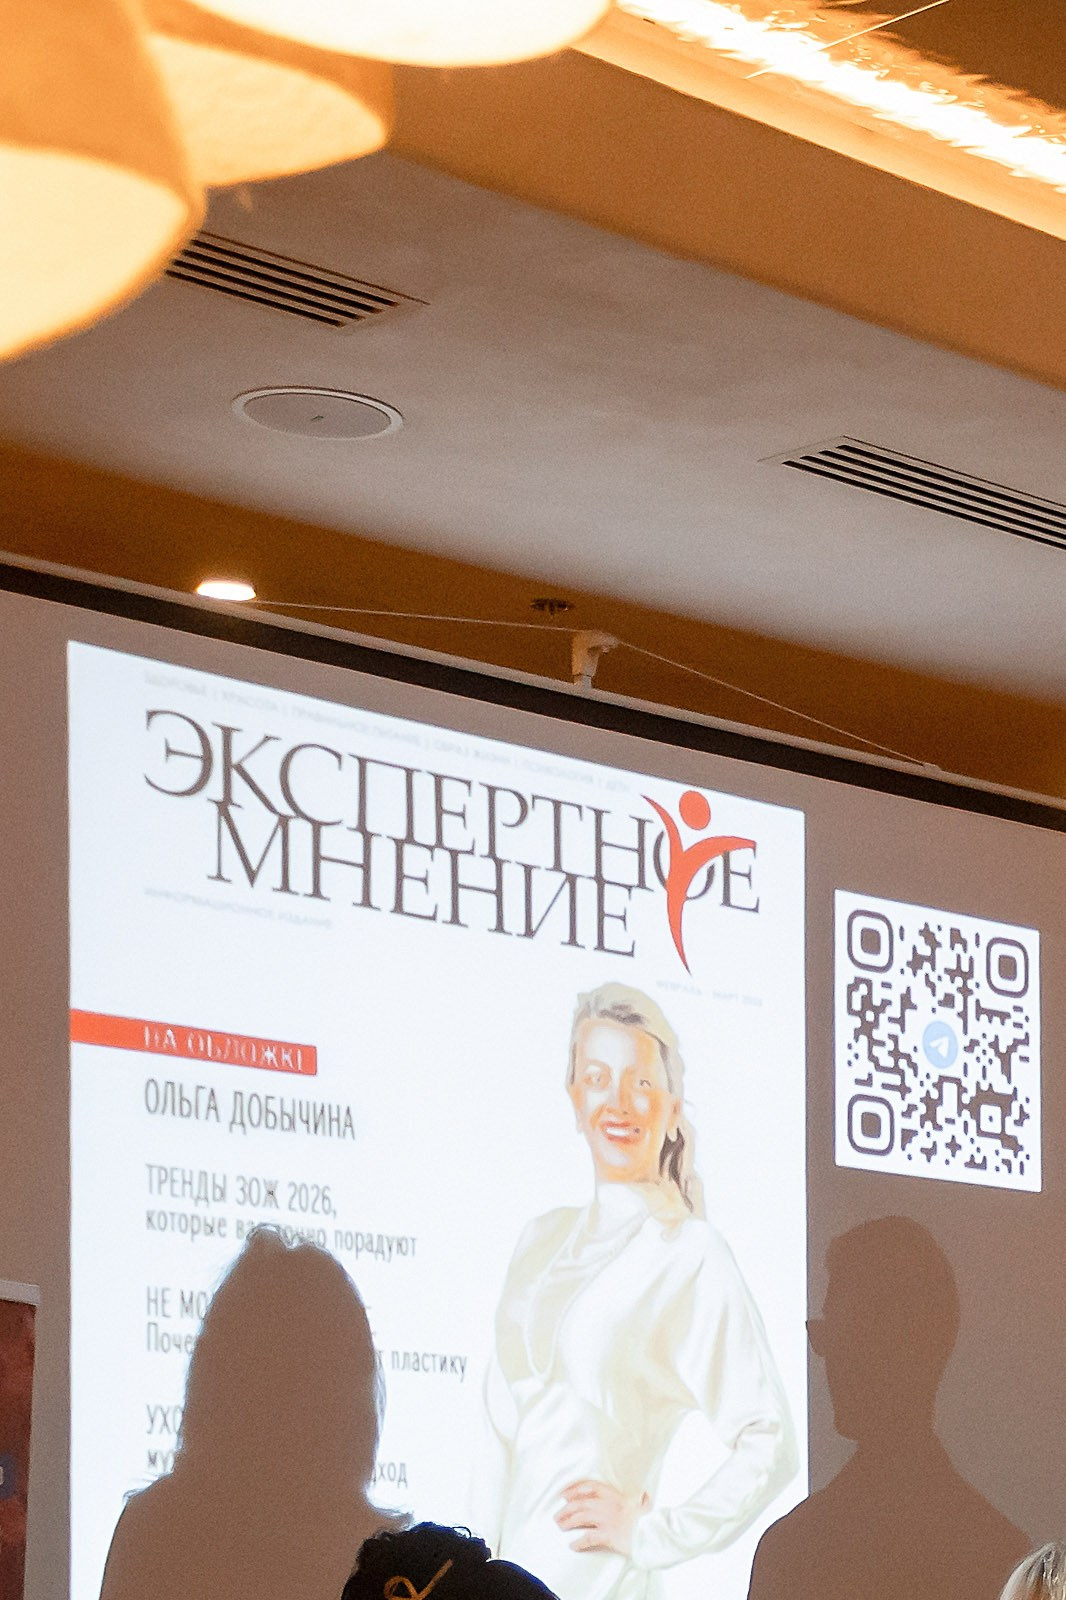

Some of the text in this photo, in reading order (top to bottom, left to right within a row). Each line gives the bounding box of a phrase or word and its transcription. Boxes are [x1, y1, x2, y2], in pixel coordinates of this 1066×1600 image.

[144, 709, 761, 913] ЭКСПЕРТНОЕ
[206, 801, 637, 958] МНЕНИЕ
[144, 1078, 357, 1140] ОЛЬГА ДОБЫЧИНА
[145, 1163, 338, 1219] ТРЕНДЫ ЗОЖ 2026,
[145, 1209, 228, 1242] которые
[334, 1228, 418, 1263] порадуют
[146, 1286, 172, 1319] НЕ
[146, 1321, 197, 1354] Поче
[391, 1350, 468, 1384] пластику
